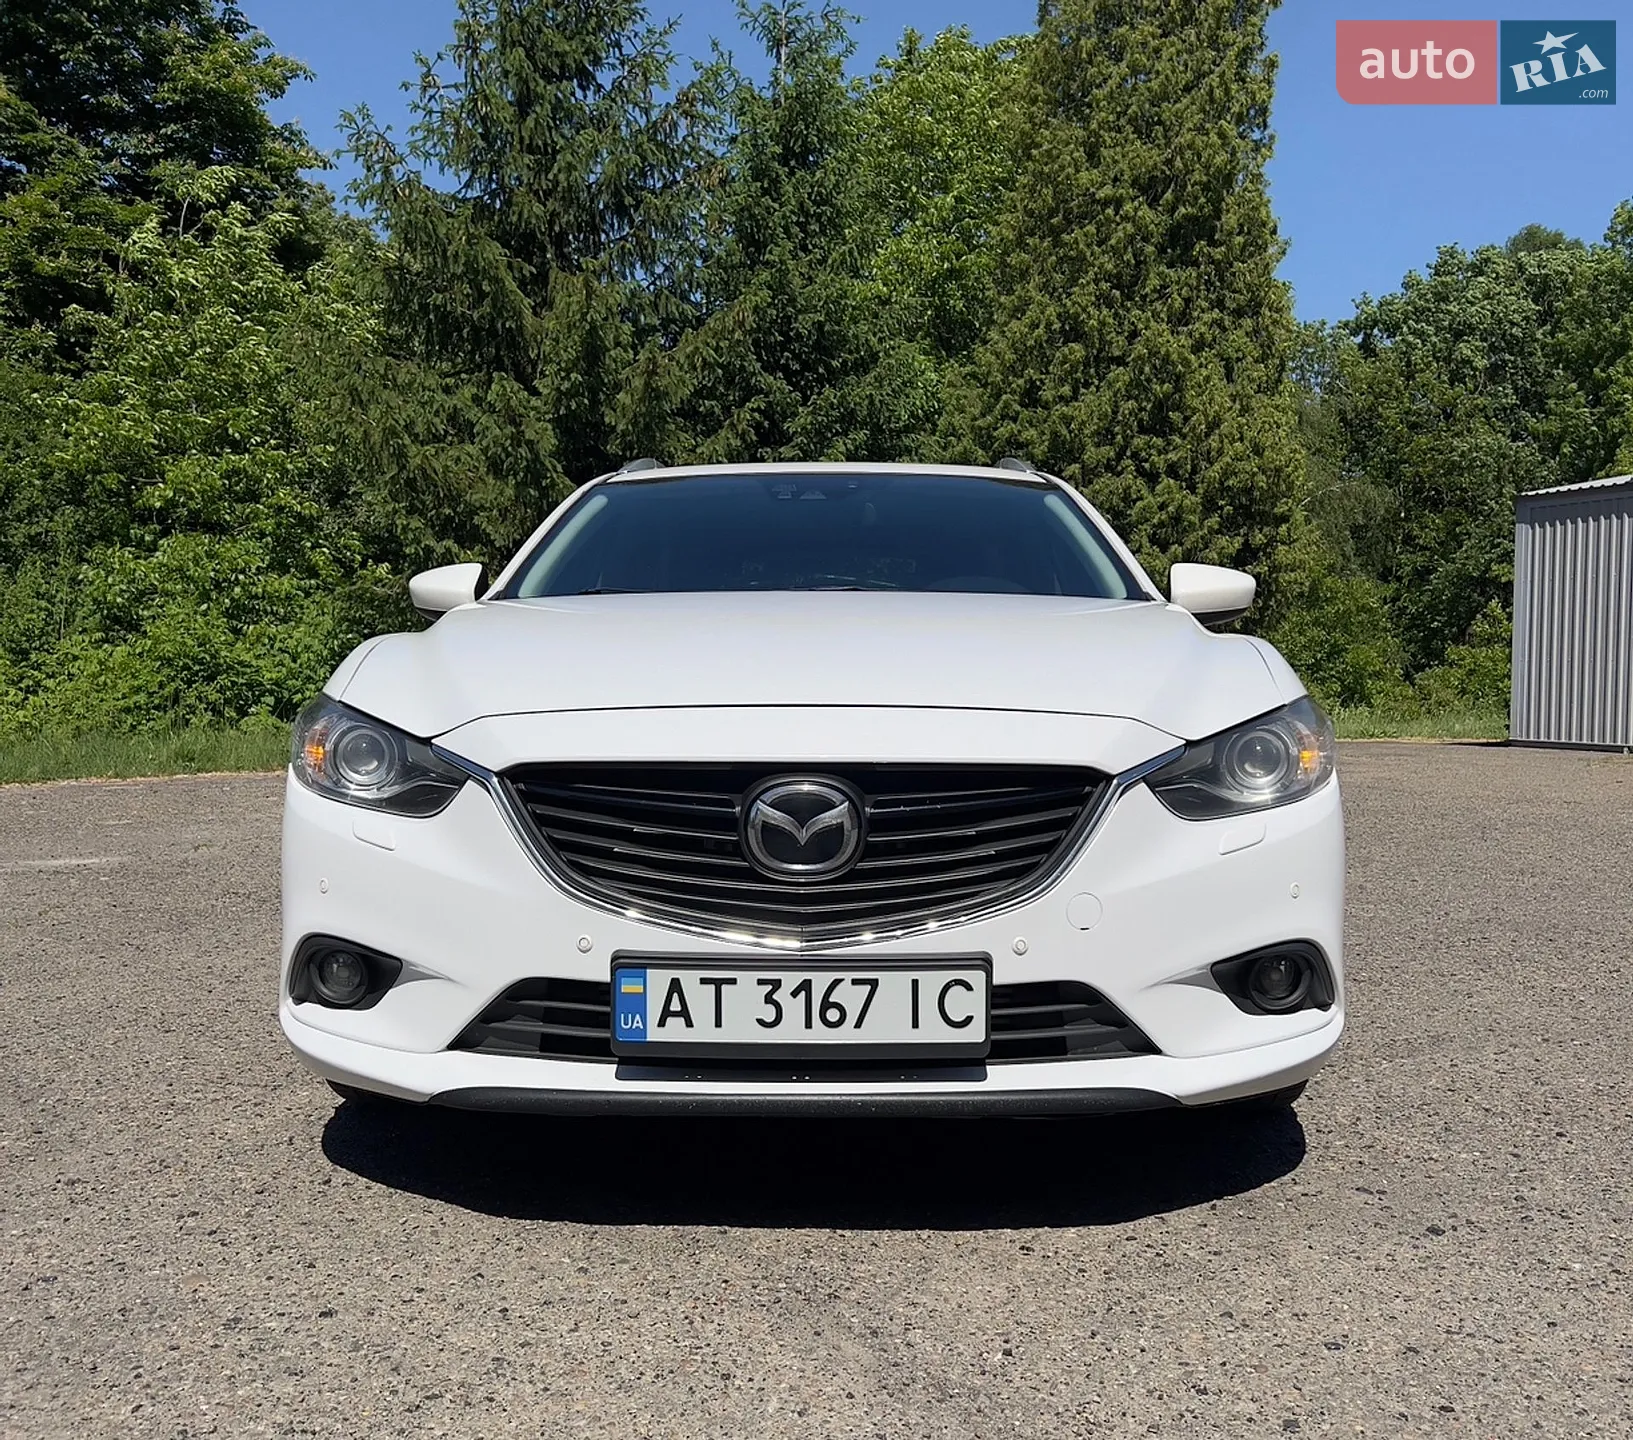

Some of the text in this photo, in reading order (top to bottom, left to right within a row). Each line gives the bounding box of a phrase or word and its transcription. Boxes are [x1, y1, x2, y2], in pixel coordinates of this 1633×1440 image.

[656, 977, 975, 1030] AT 3167 IC
[620, 1013, 644, 1030] UA
